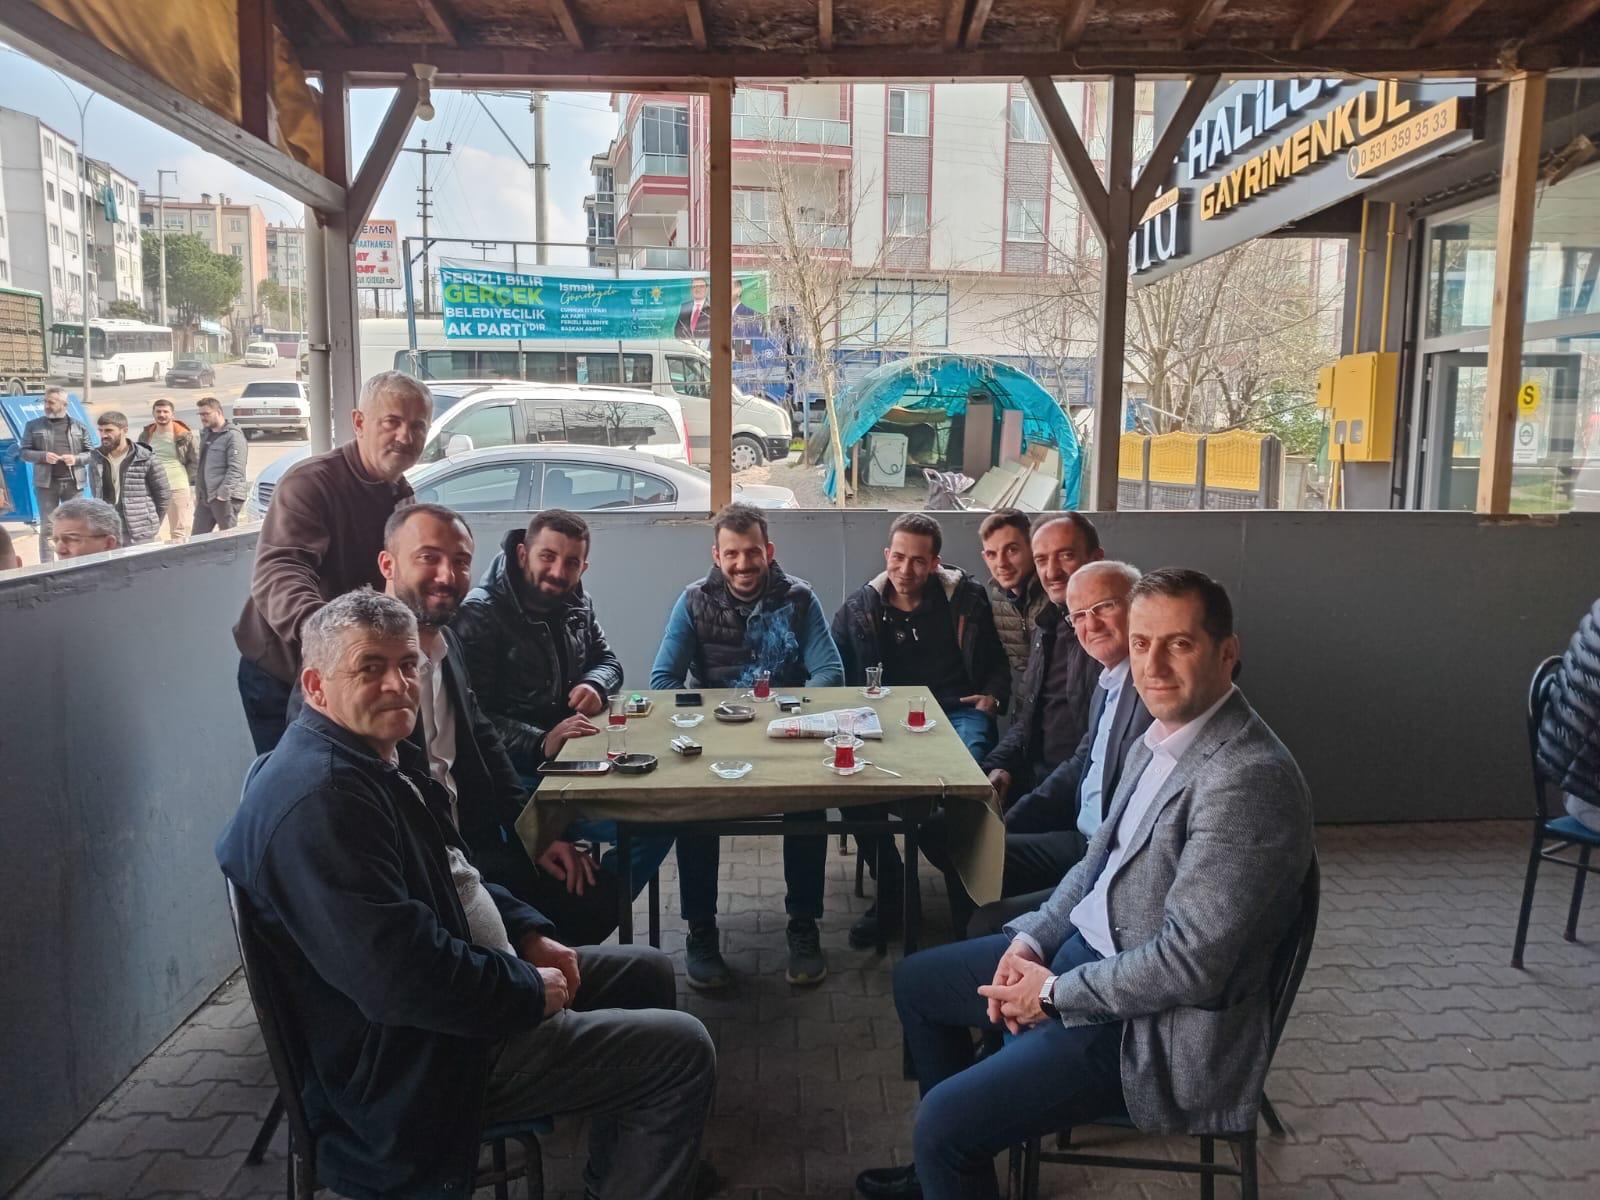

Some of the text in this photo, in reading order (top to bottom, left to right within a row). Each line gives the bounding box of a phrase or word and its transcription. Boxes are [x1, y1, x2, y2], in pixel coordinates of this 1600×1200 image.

[1360, 108, 1448, 166] 0 531 359 35 33
[1201, 79, 1410, 221] GAYRİMENKUL
[360, 225, 393, 234] EMEN
[355, 252, 370, 261] AY
[355, 265, 377, 273] OST
[445, 284, 545, 308] GERÇEK
[447, 322, 473, 336] AK
[1523, 385, 1535, 405] S
